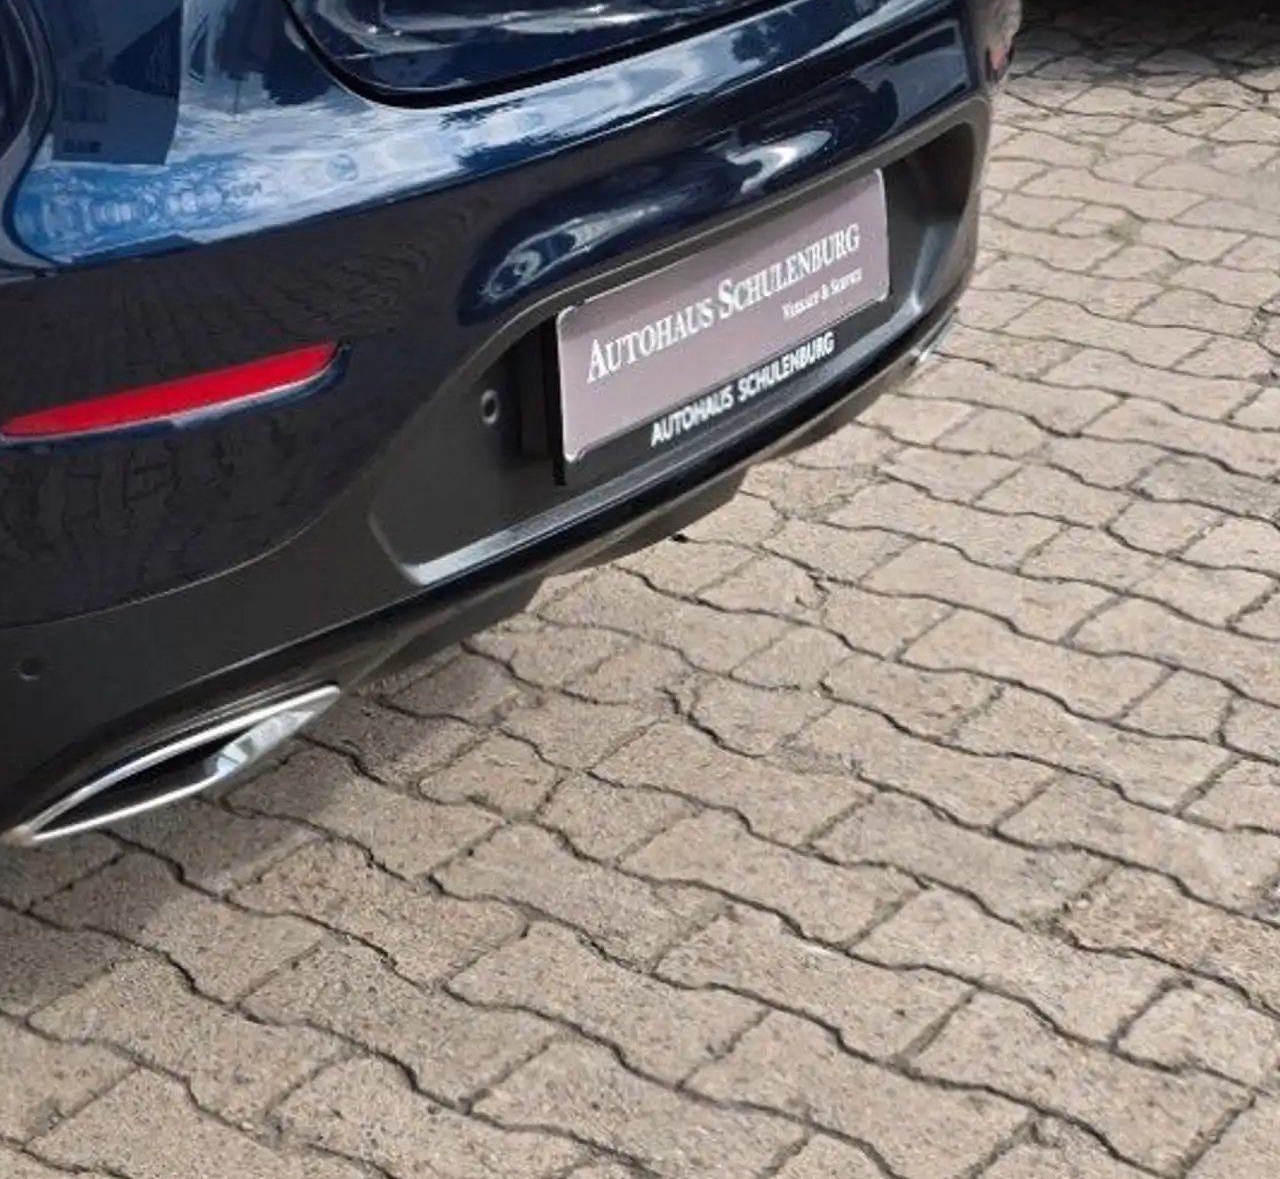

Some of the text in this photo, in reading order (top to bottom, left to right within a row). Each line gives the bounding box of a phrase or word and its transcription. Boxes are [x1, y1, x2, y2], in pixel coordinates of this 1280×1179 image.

[587, 224, 860, 384] AUTOHAUS SCHULENBURG
[651, 331, 835, 447] AUTOHAUS SCHULENBURG
